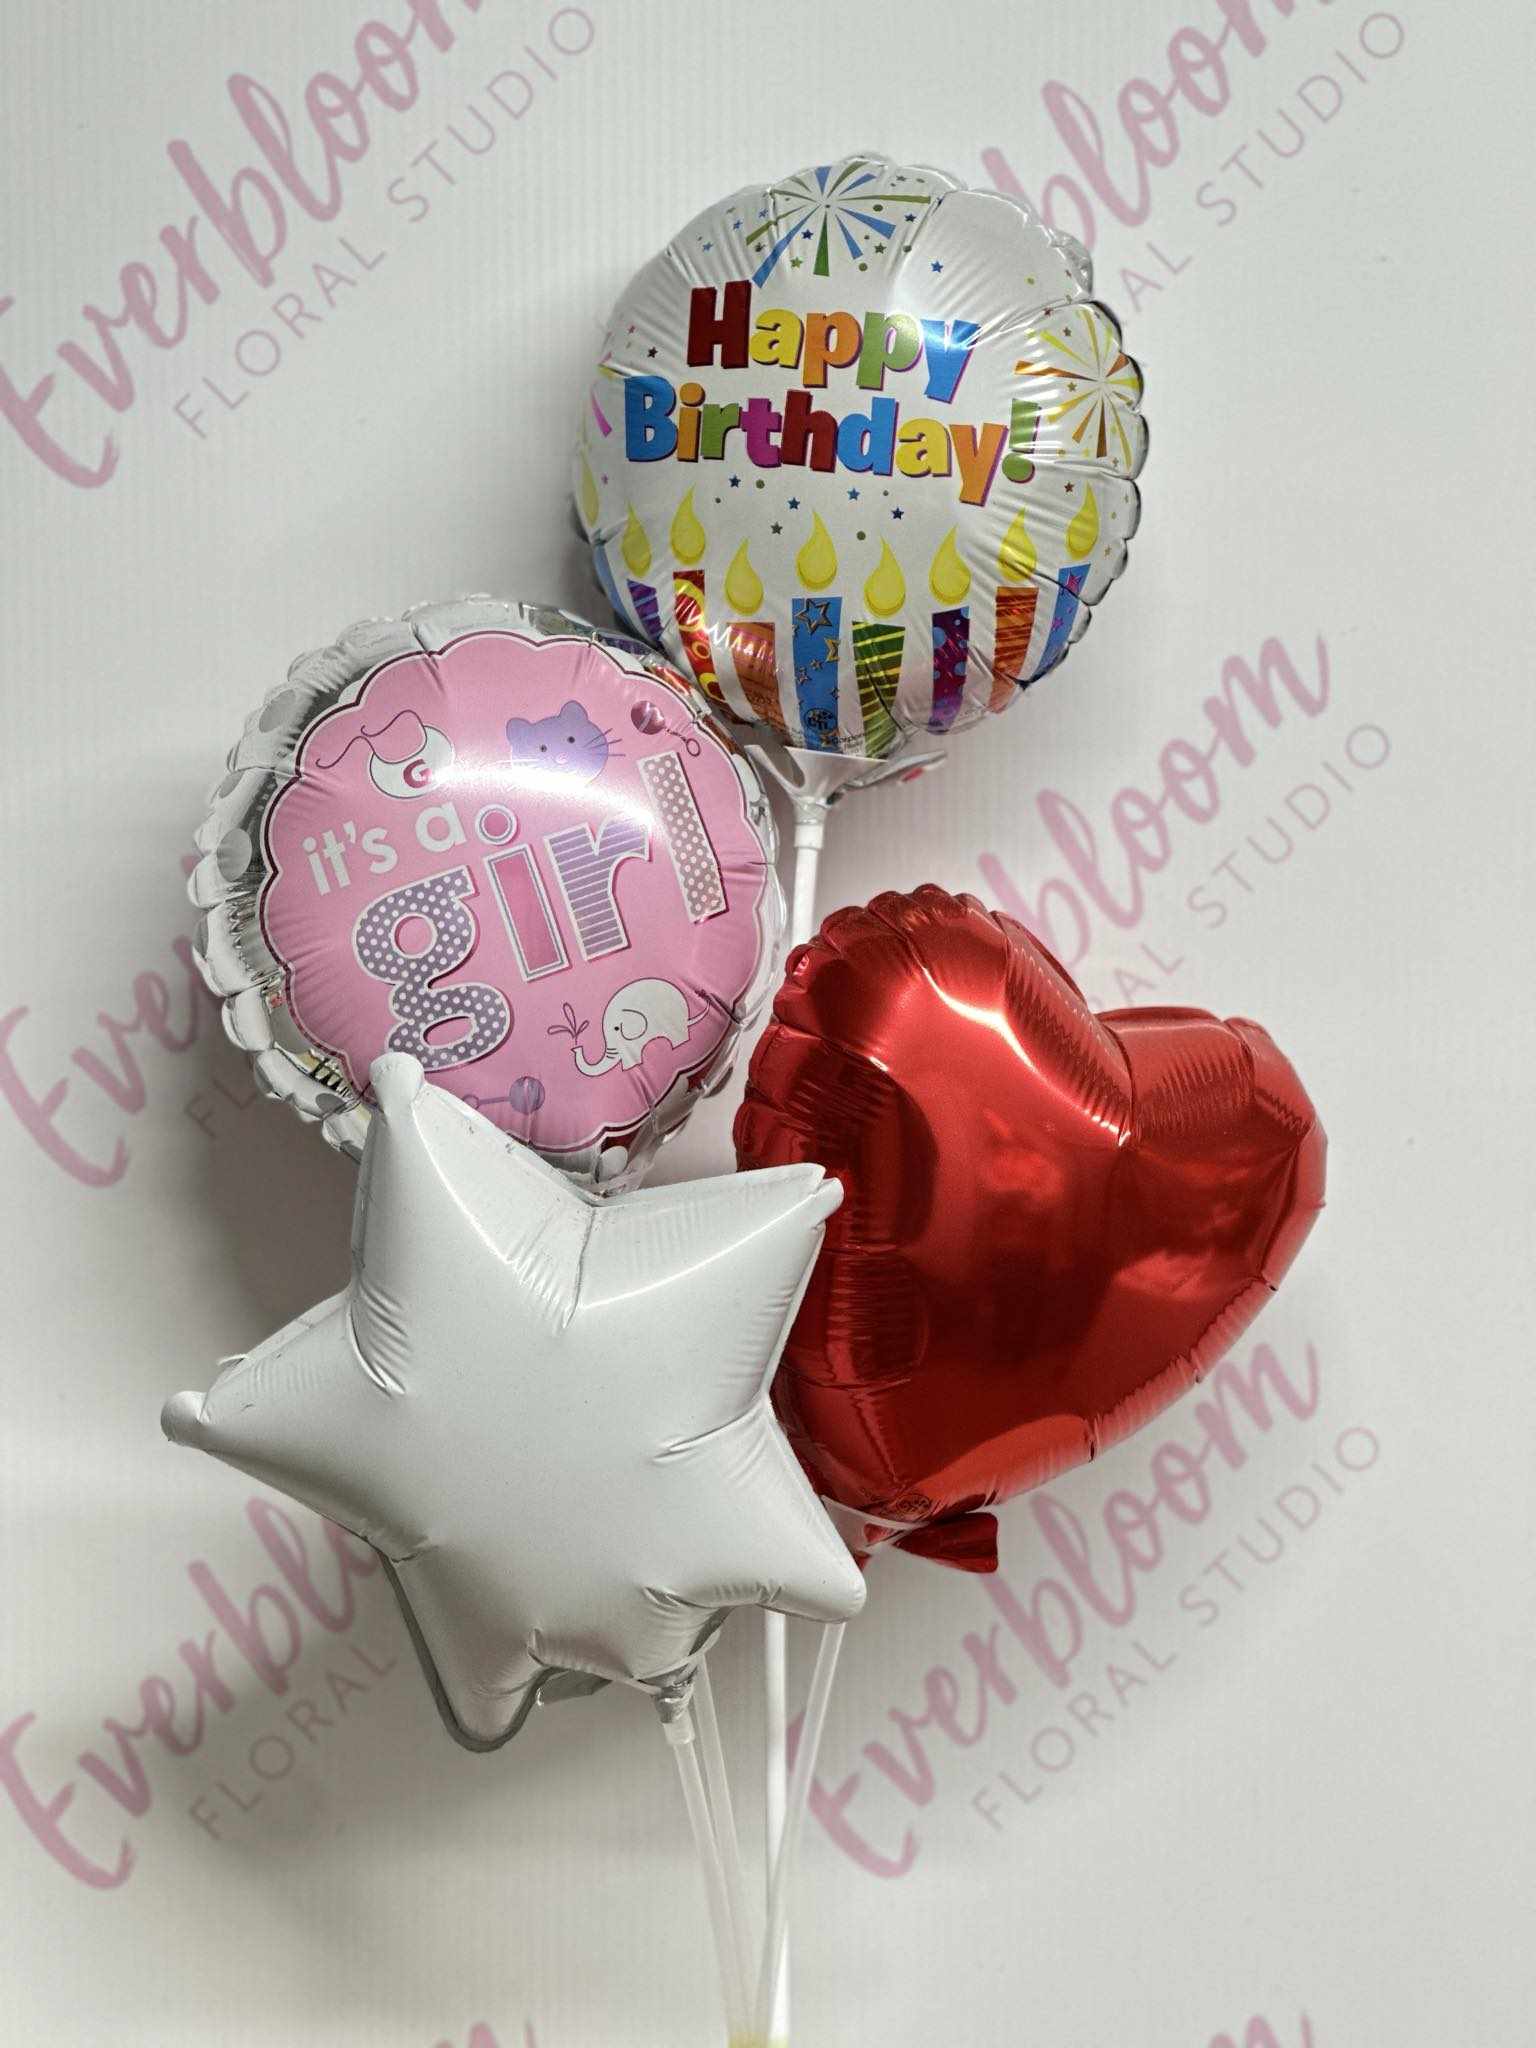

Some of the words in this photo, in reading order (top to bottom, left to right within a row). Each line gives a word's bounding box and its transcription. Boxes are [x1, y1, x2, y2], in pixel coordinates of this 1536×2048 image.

[0, 0, 482, 489] Everbloo
[172, 236, 387, 440] FLORAL
[386, 7, 596, 224] STUDIO
[1195, 12, 1406, 227] STUDIO
[624, 374, 1042, 507] Birthday!
[686, 279, 981, 404] Happy
[301, 820, 399, 896] it's
[415, 801, 468, 853] a
[354, 752, 728, 1071] girl
[977, 633, 1331, 972] bloom
[1185, 722, 1391, 931] STUDIO
[0, 1496, 386, 1890] Everbl
[188, 1641, 398, 1840] FLORAL
[970, 1639, 1179, 1832] FLORAL
[1180, 1425, 1381, 1629] STUDIO
